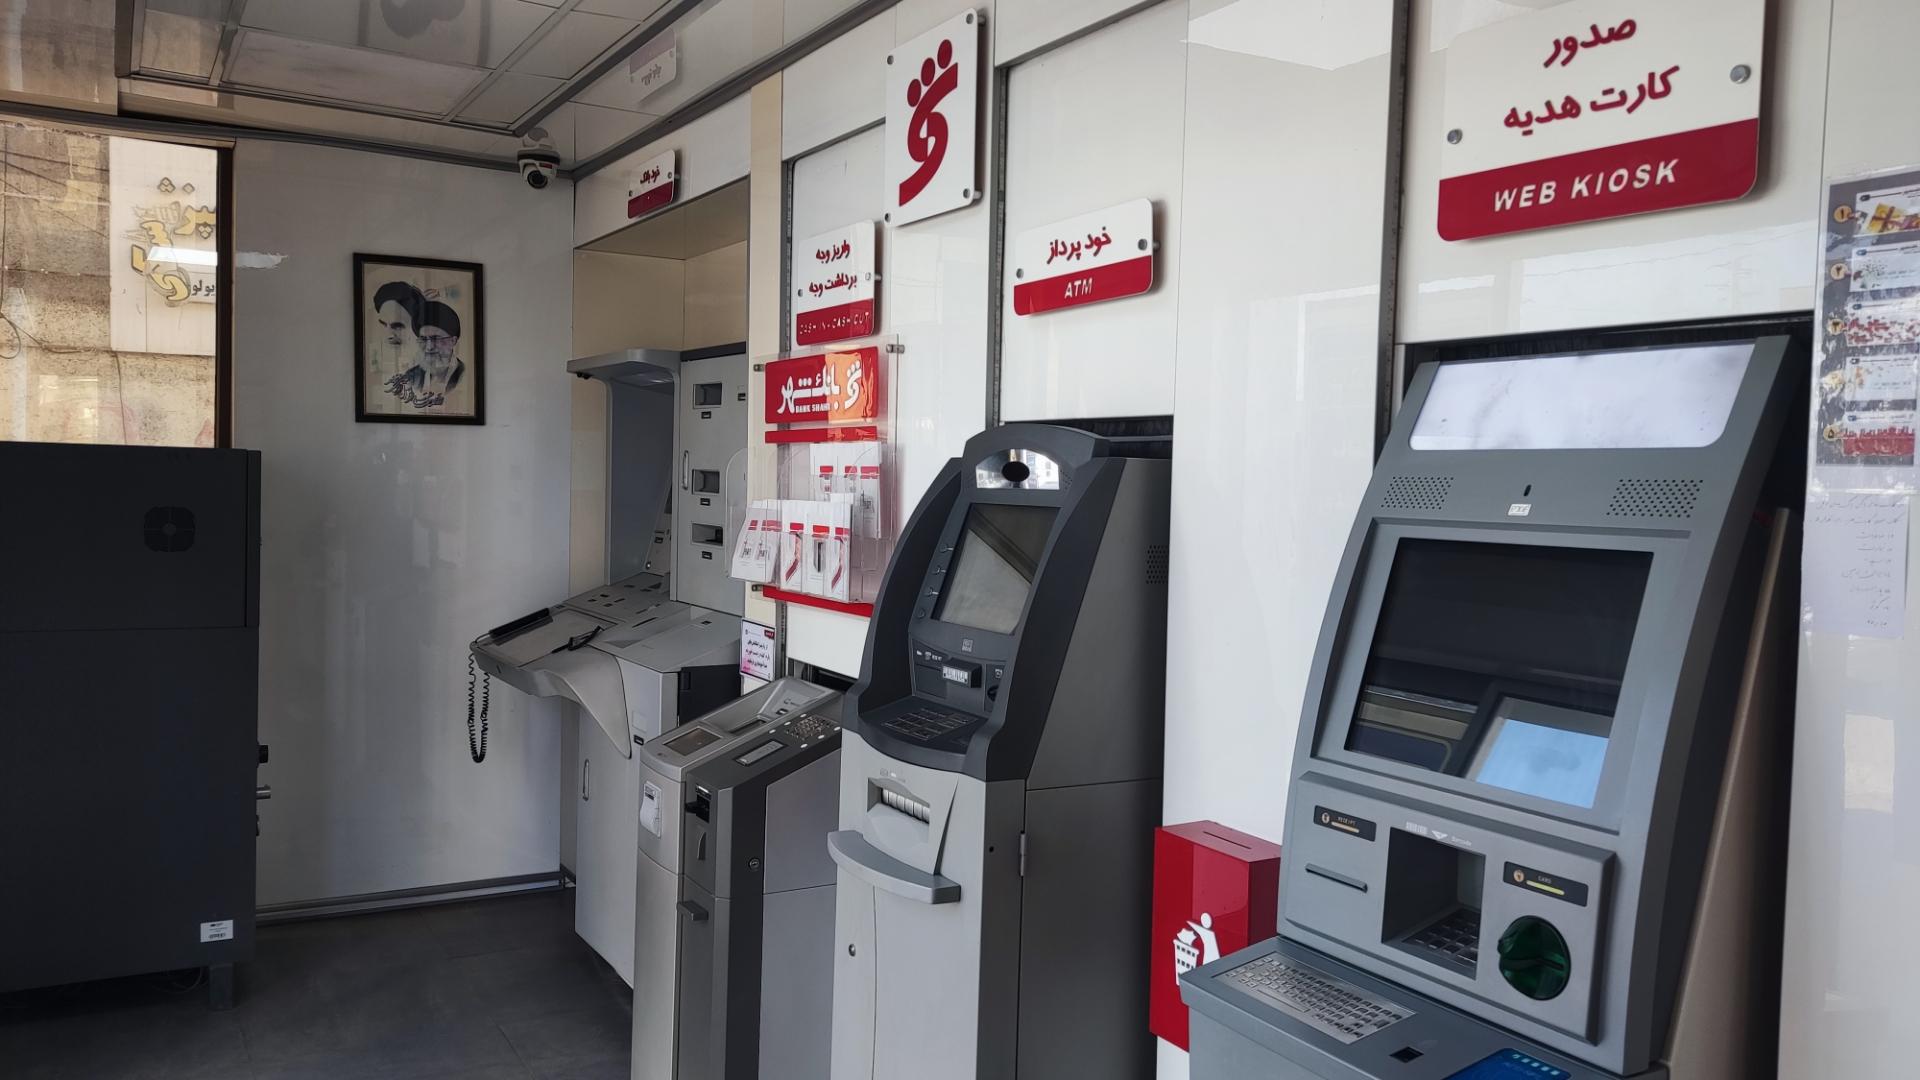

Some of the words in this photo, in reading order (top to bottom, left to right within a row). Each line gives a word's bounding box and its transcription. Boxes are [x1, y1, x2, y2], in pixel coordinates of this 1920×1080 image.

[1543, 18, 1637, 68] صدور
[1590, 65, 1680, 114] کارت
[1503, 95, 1582, 136] هدیه
[1493, 181, 1557, 212] WEB
[1570, 159, 1679, 199] KIOSK
[831, 239, 851, 262] واریز
[1046, 239, 1081, 265] پرداز
[1084, 226, 1112, 257] خود
[816, 248, 830, 264] وجه
[809, 282, 823, 298] وجه
[824, 272, 858, 290] برداشت
[1064, 277, 1093, 299] ATM
[777, 375, 812, 414] شهر
